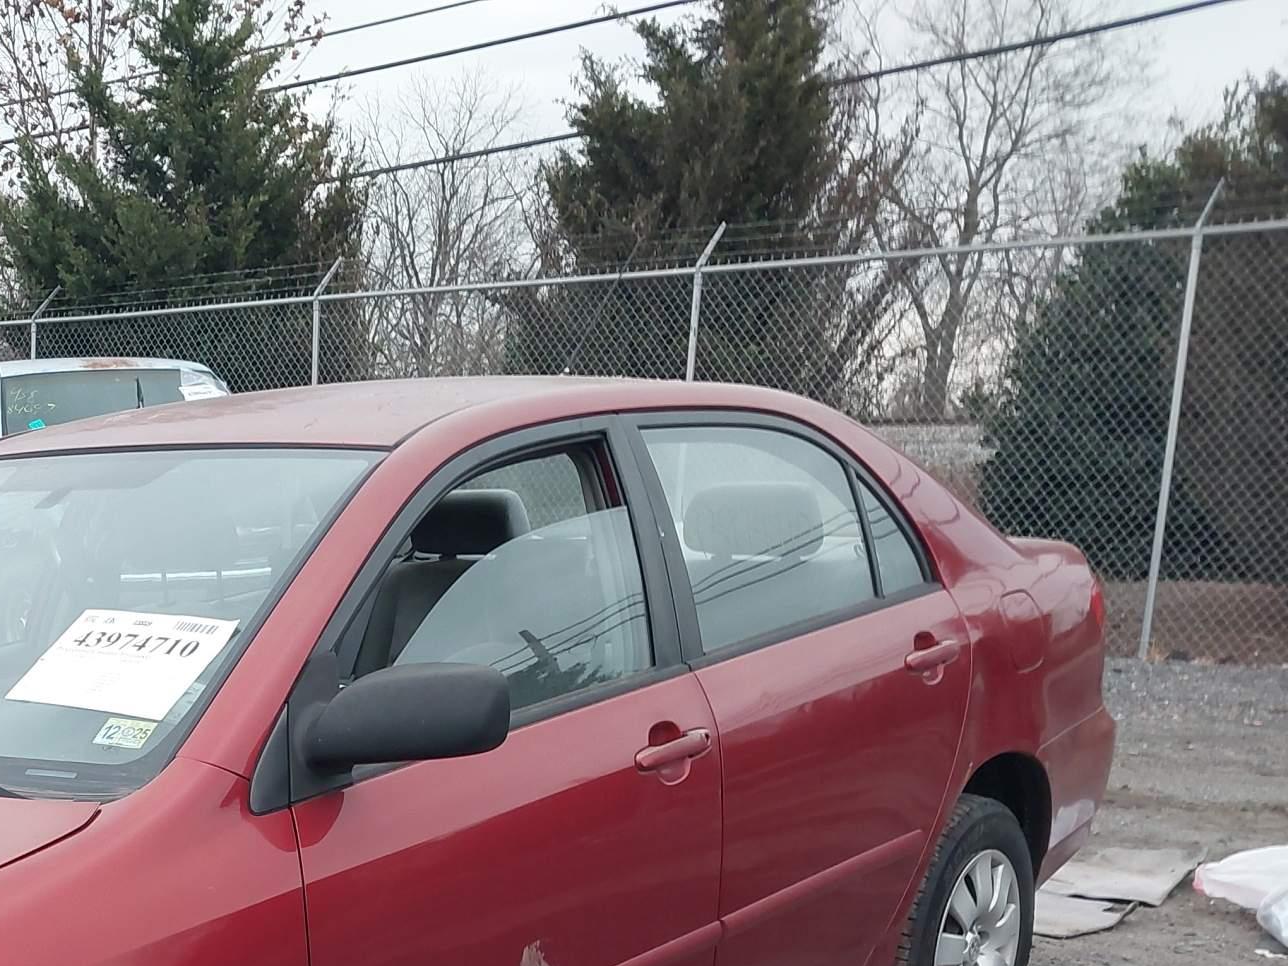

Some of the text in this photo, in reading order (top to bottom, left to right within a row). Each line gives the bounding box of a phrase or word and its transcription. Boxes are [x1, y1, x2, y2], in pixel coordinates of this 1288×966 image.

[74, 630, 200, 658] 43974710
[102, 724, 121, 740] 12
[132, 727, 151, 740] 25
